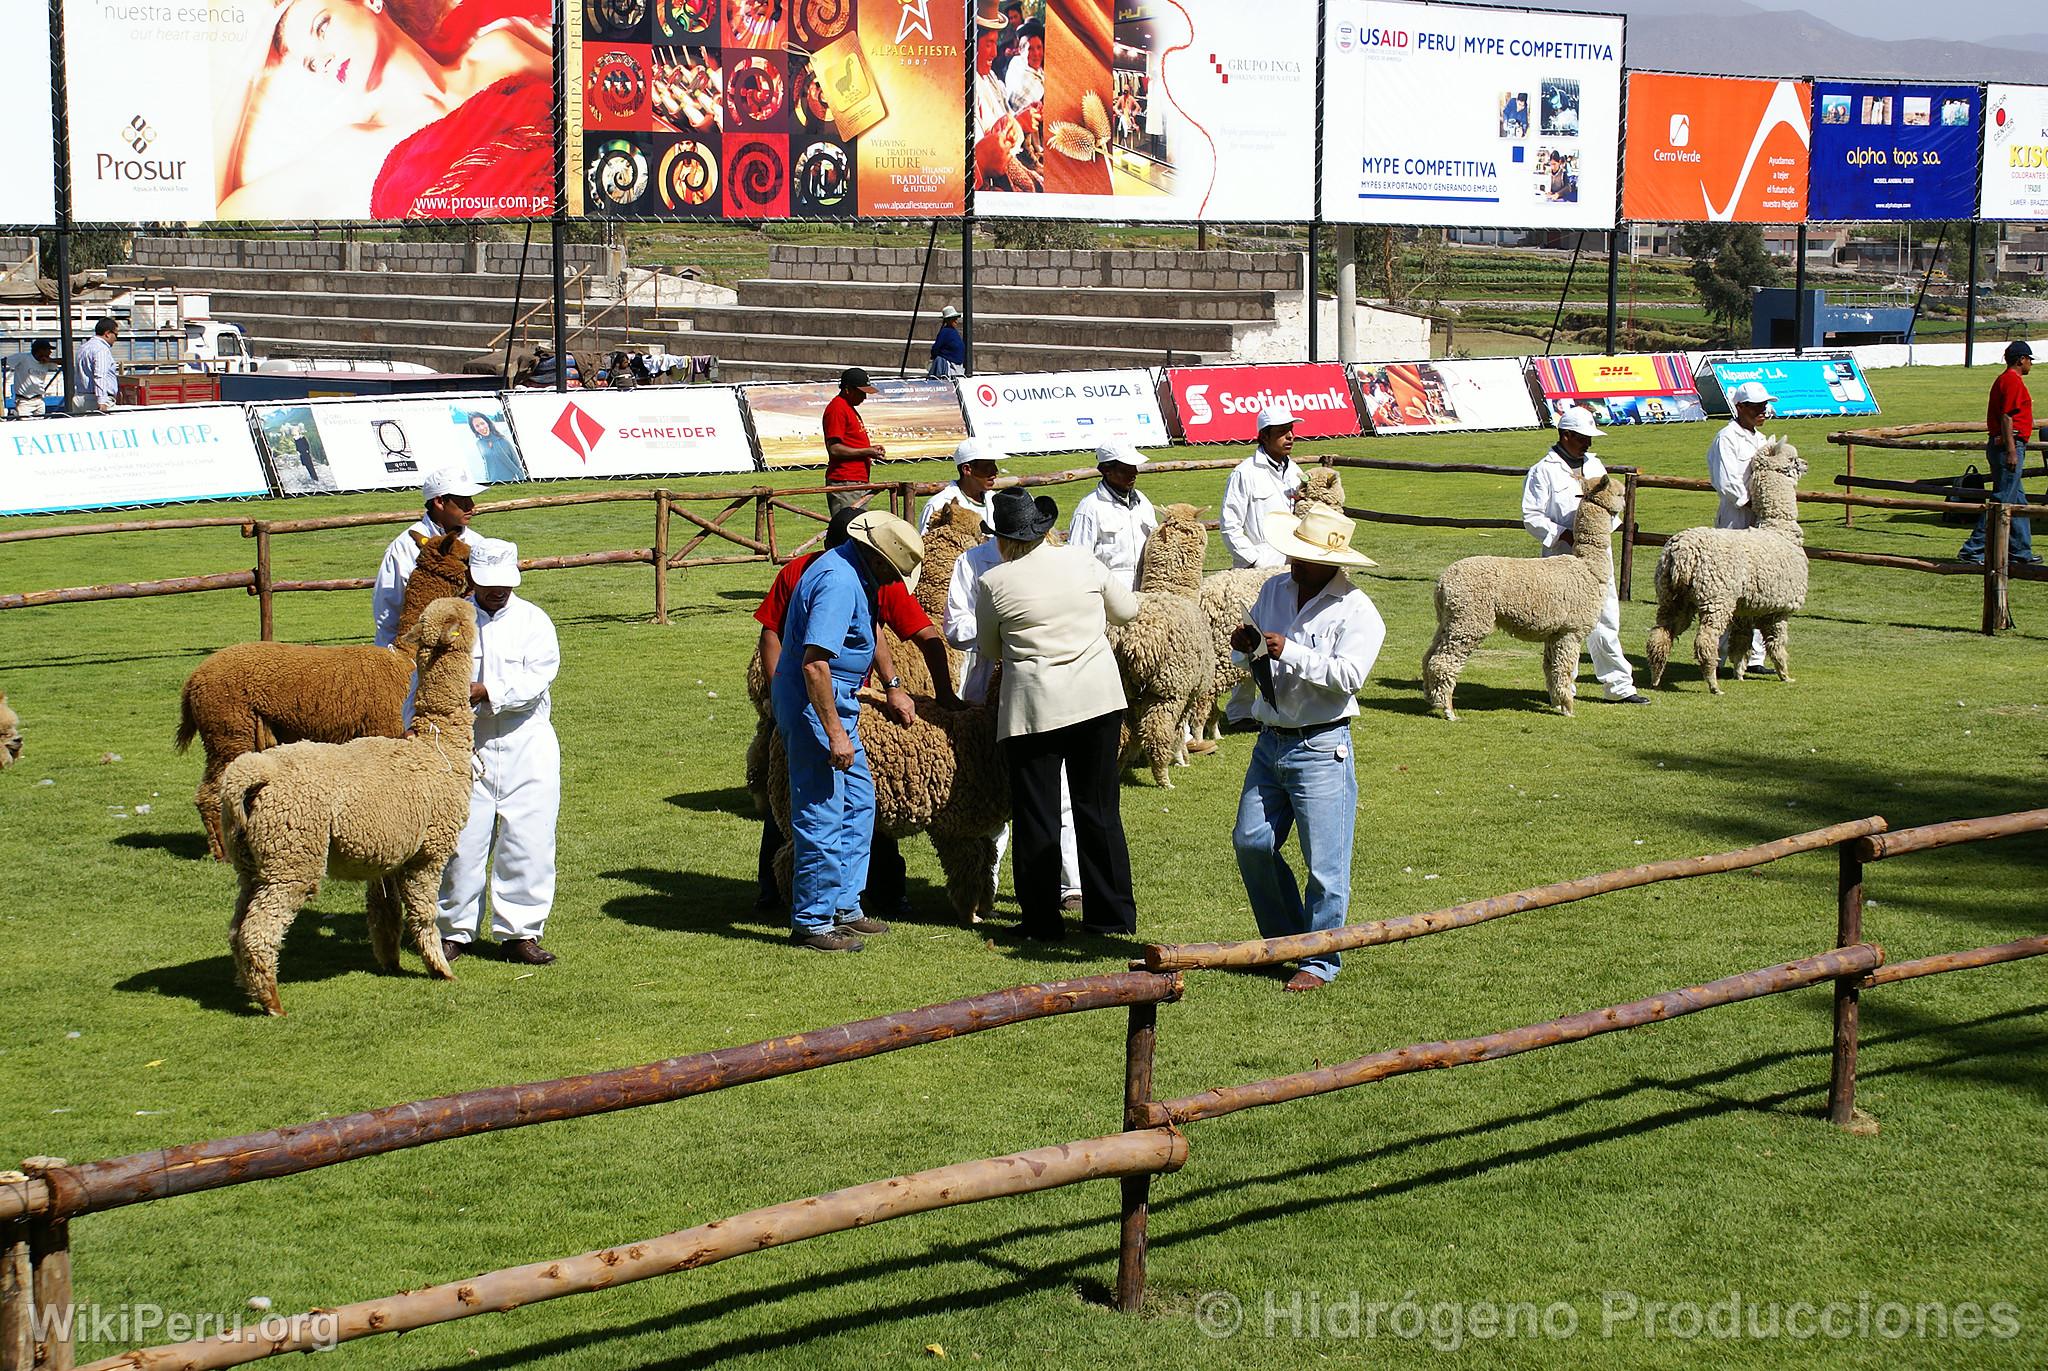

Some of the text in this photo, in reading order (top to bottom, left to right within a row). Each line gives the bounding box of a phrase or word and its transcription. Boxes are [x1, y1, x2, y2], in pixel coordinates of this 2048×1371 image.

[105, 5, 245, 23] nuestra esencia
[571, 1, 582, 49] PERU
[872, 45, 957, 56] ALPACA FIESTA
[1360, 27, 1613, 61] USAID PERU MYPE COMPETITIVA
[1228, 59, 1301, 72] GRUPO INCA
[1989, 94, 2007, 115] COLOR
[571, 75, 583, 177] AREQUIPA
[1993, 118, 2014, 141] CENTER
[875, 157, 921, 168] FUTURE
[1653, 148, 1701, 162] Cerro Verde
[1768, 156, 1795, 166] Ayudamos
[1846, 146, 1941, 168] alpha tops s.a.
[97, 153, 187, 180] Prosur
[1362, 157, 1497, 178] MYPE COMPETITIVA
[2011, 171, 2046, 179] COLORANTES
[1787, 185, 1795, 193] de
[415, 196, 549, 214] www.prosur.com.pe
[874, 200, 954, 210] www.alpacafiestaperu.com
[1599, 366, 1633, 376] DHL
[1003, 384, 1130, 403] QUIMICA SUIZA
[1219, 387, 1348, 415] Scotiabank
[152, 424, 219, 446] CORP.
[618, 427, 716, 439] SCHNEIDER
